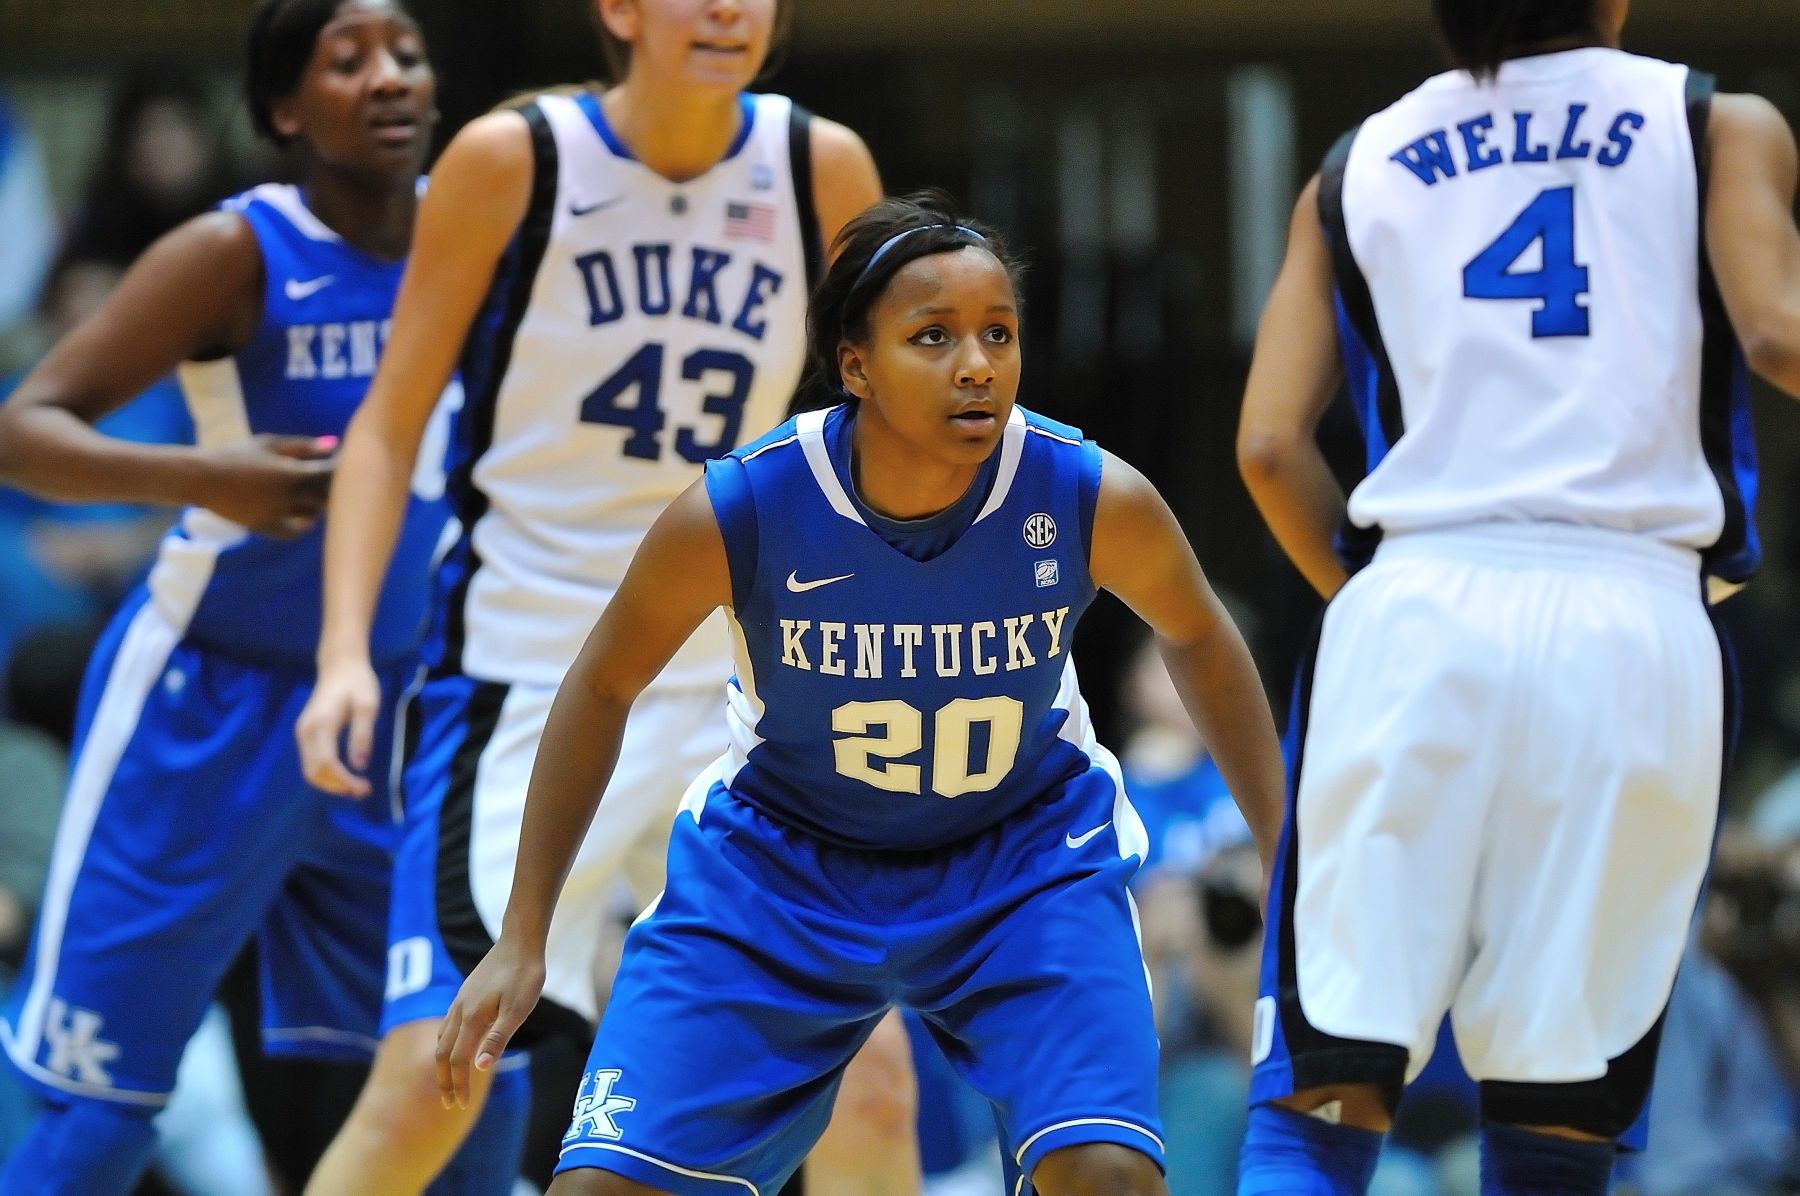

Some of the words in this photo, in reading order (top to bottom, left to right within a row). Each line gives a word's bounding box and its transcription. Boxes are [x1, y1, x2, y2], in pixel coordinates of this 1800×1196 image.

[1389, 104, 1645, 186] WELLS
[575, 244, 784, 340] DUKE
[1463, 186, 1589, 338] 4
[579, 342, 755, 464] 43
[1026, 516, 1054, 545] SEC
[779, 606, 1070, 679] KENTUCKY
[831, 695, 1024, 798] 20
[385, 936, 433, 1003] D
